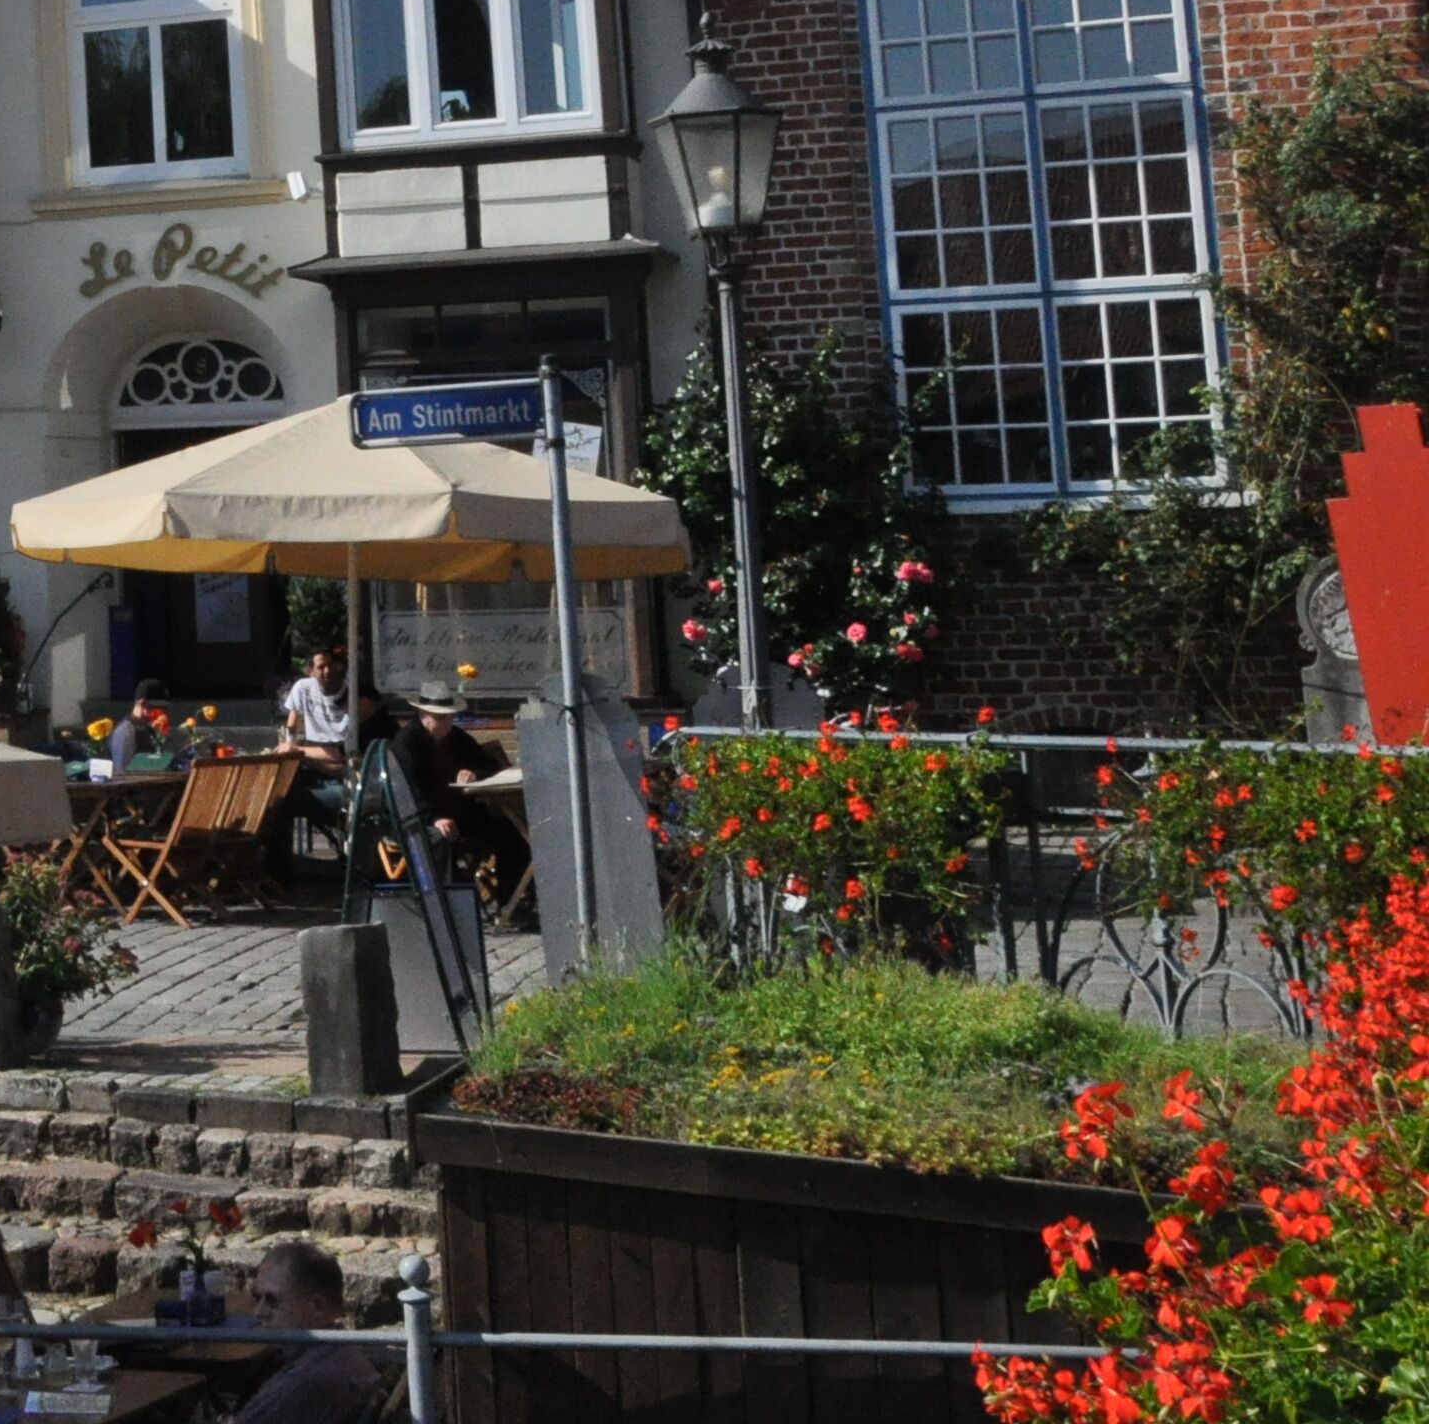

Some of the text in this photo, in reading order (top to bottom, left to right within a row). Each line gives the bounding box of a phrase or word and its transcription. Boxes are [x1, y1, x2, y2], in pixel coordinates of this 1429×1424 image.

[79, 223, 286, 299] Le Petit
[368, 399, 532, 432] Am Stintmarkt
